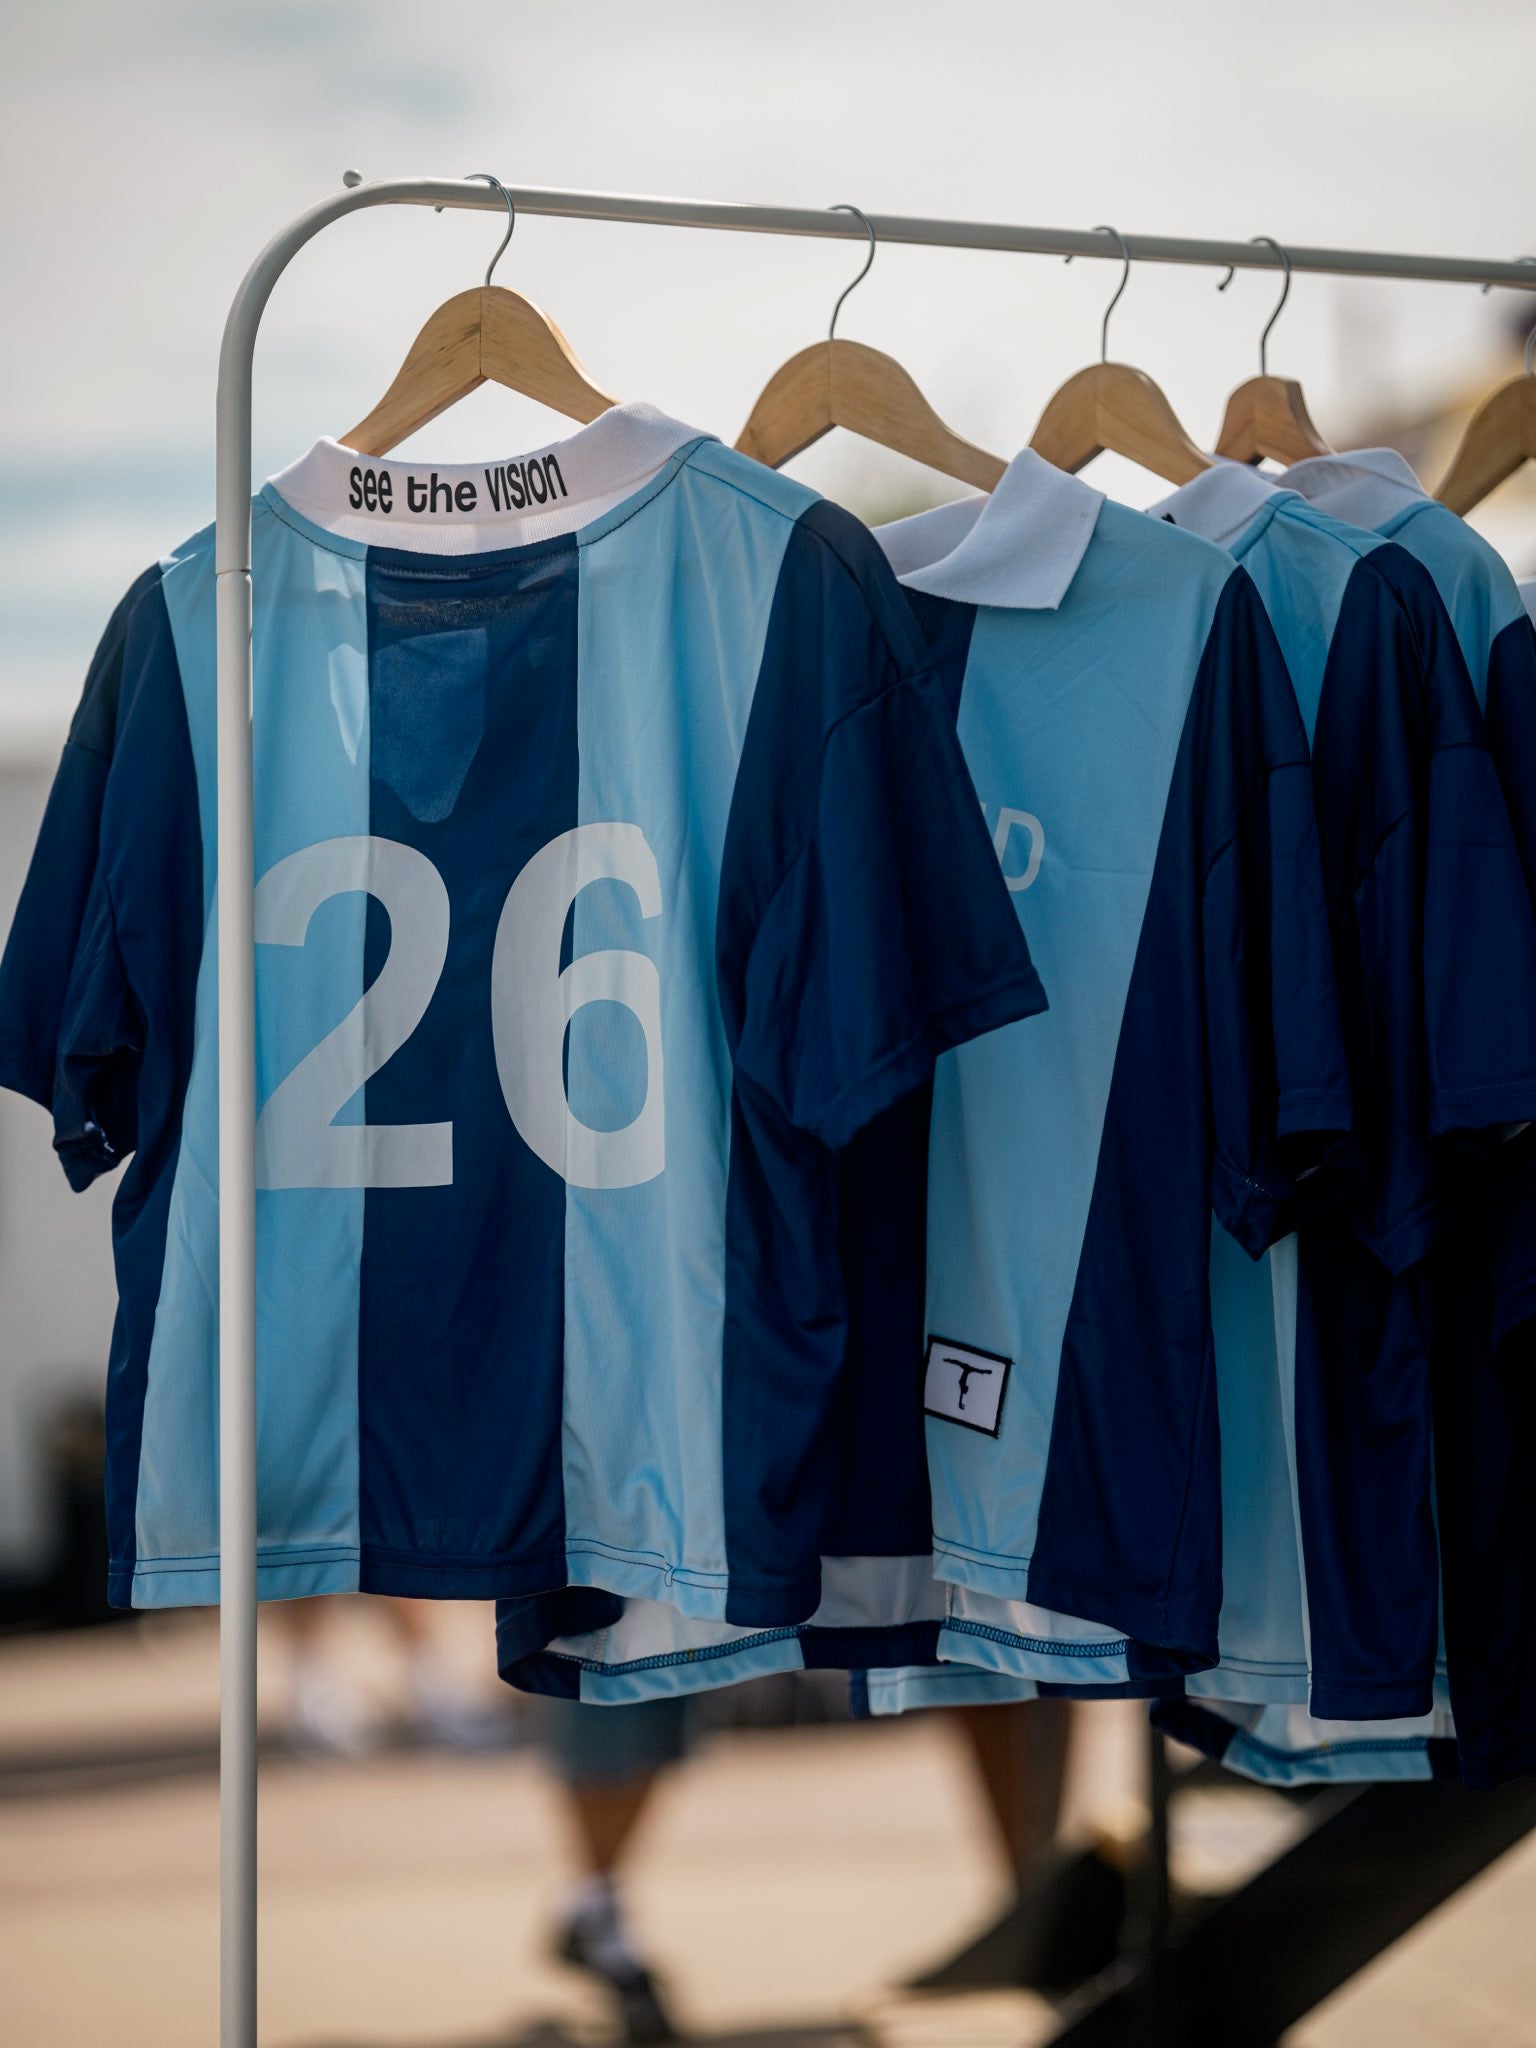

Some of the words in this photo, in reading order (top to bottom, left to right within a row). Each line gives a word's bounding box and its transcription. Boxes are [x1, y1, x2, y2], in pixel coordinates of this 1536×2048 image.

[349, 466, 393, 514] see
[407, 473, 478, 513] the
[254, 821, 665, 1190] 26
